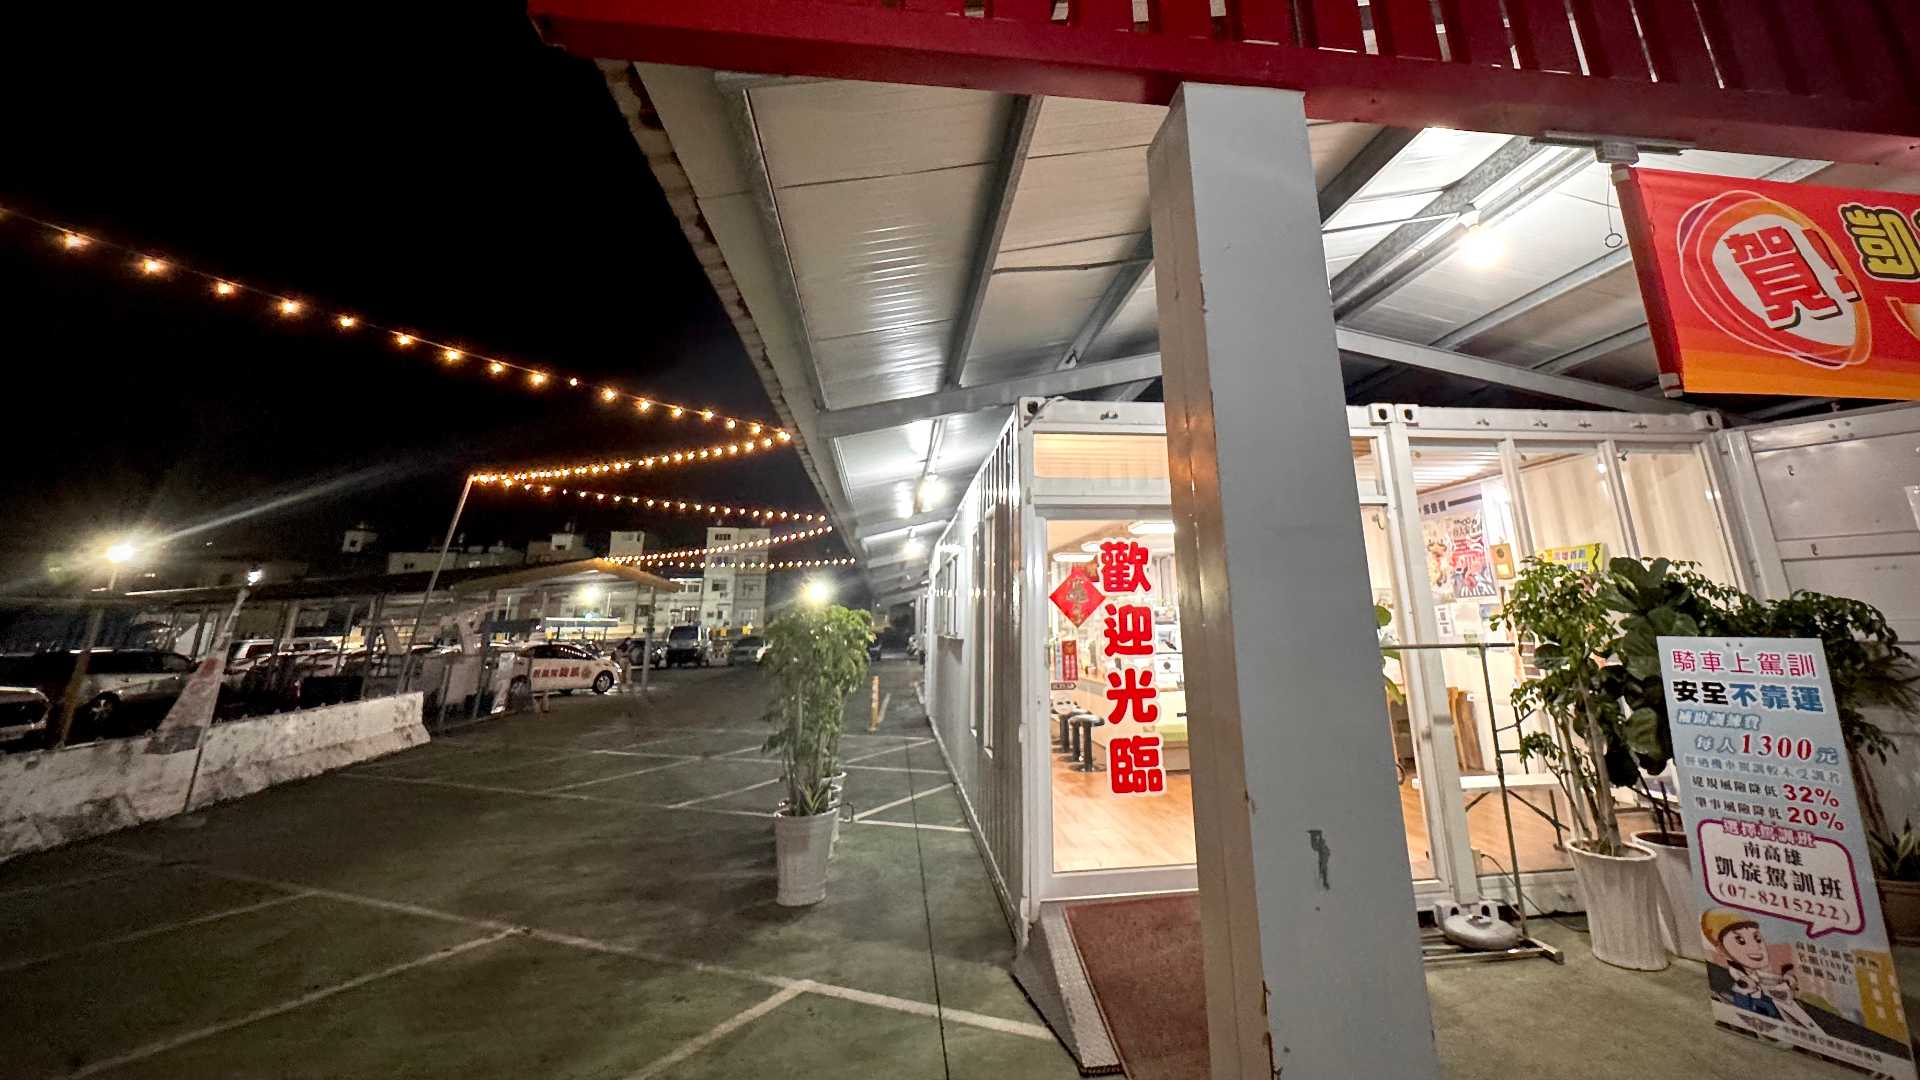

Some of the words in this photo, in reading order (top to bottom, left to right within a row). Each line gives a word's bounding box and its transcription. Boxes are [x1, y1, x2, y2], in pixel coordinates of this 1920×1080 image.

[1841, 203, 1920, 282] 凱
[1099, 539, 1164, 795] 歡迎光臨
[1672, 648, 1817, 678] 騎車上駕訓
[1673, 681, 1825, 713] 安全不靠運
[1744, 841, 1804, 867] 南高雄
[1715, 855, 1845, 900] 凱旋駕訓班
